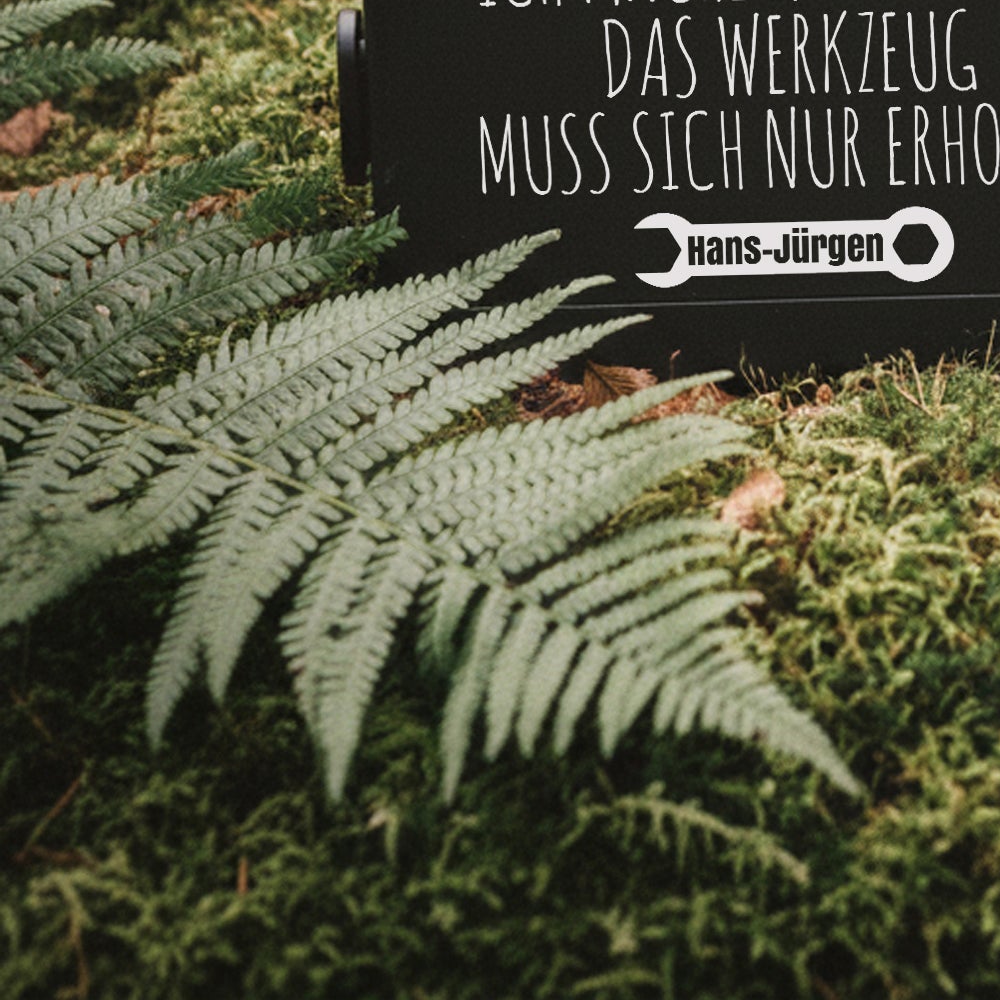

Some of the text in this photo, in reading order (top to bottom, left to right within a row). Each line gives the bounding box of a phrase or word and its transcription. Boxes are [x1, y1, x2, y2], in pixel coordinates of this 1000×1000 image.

[602, 8, 978, 99] DAS WERKZEUG
[479, 110, 611, 198] MUSS
[632, 109, 744, 194] SICH
[766, 105, 866, 190] NUR
[687, 227, 884, 267] Hans-Jürgen
